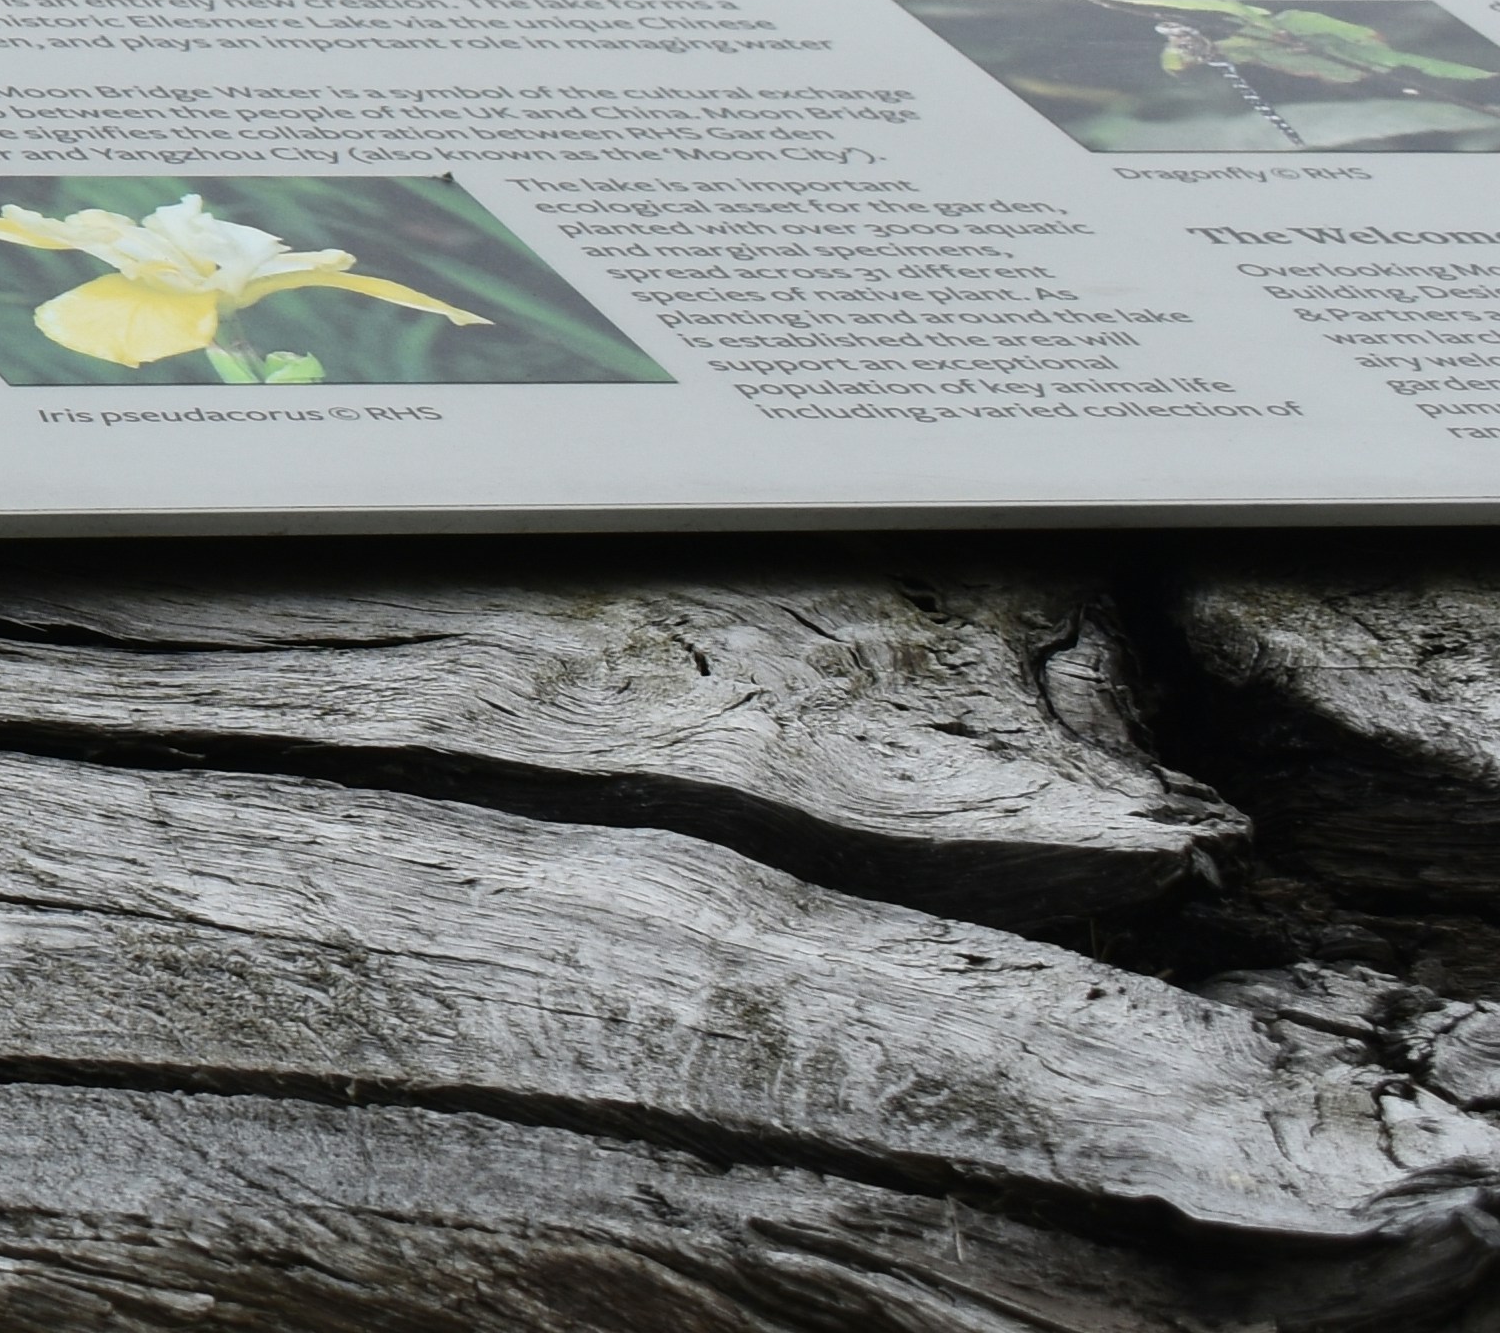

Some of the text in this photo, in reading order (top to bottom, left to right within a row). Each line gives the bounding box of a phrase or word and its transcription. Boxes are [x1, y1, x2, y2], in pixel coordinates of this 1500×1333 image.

[716, 0, 740, 10] a
[126, 15, 304, 29] Ellesmere
[305, 15, 392, 29] Lake
[393, 16, 447, 29] via
[448, 16, 510, 29] the
[513, 16, 634, 33] unique
[637, 17, 777, 30] Chinese
[47, 35, 116, 48] and
[120, 35, 212, 52] plays
[216, 38, 262, 49] an
[261, 35, 448, 53] important
[449, 36, 522, 49] role
[521, 36, 561, 49] in
[563, 37, 739, 54] managing
[734, 39, 832, 50] water
[94, 85, 213, 102] Bridge
[212, 86, 322, 99] Water
[326, 86, 360, 99] is
[363, 89, 388, 99] a
[388, 86, 514, 102] symbol
[518, 86, 553, 99] of
[557, 86, 618, 99] the
[622, 86, 753, 100] cultural
[758, 86, 916, 104] exchange
[9, 105, 167, 119] between
[168, 106, 231, 119] the
[235, 106, 356, 123] people
[360, 106, 395, 119] of
[399, 106, 462, 119] the
[462, 107, 520, 119] UK
[521, 106, 588, 119] and
[590, 106, 701, 120] China.
[701, 107, 804, 120] Moon
[804, 107, 921, 124] Bridge
[23, 125, 168, 144] signifies
[170, 126, 233, 140] the
[238, 126, 470, 140] collaboration
[469, 126, 624, 140] between
[624, 127, 703, 140] RHS
[705, 127, 835, 140] Garden
[21, 147, 90, 161] and
[89, 147, 267, 164] Yangzhou
[269, 147, 339, 164] City
[348, 147, 433, 164] (also
[433, 147, 557, 161] known
[559, 150, 600, 161] as
[600, 147, 663, 161] the
[1112, 167, 1268, 183] Dragonfly
[1301, 167, 1373, 180] RHS
[505, 178, 920, 196] The lake is an important
[535, 199, 1068, 218] ecological asset for the garden,
[557, 220, 1095, 239] planted with over 3000 aquatic
[1185, 226, 1500, 246] The Welcom
[581, 242, 1014, 261] and marginal specimens,
[606, 264, 1056, 284] spread across 31 different
[1236, 263, 1458, 281] Overlooking
[630, 286, 1079, 306] species of native plant. As
[1262, 284, 1500, 303] Building. Desi
[656, 308, 1194, 329] planting in and around the lake
[1293, 308, 1330, 322] &
[1325, 308, 1483, 322] Partners
[676, 331, 1141, 348] is established the area will
[1323, 334, 1430, 345] warm
[707, 355, 1120, 376] support an exceptional
[1354, 353, 1422, 372] airy
[733, 377, 1236, 400] population of key animal life
[38, 408, 94, 423] Iris
[100, 407, 325, 427] pseudacorus
[363, 406, 443, 420] RHS
[754, 401, 1304, 423] including a varied collection of
[1415, 403, 1500, 419] pum
